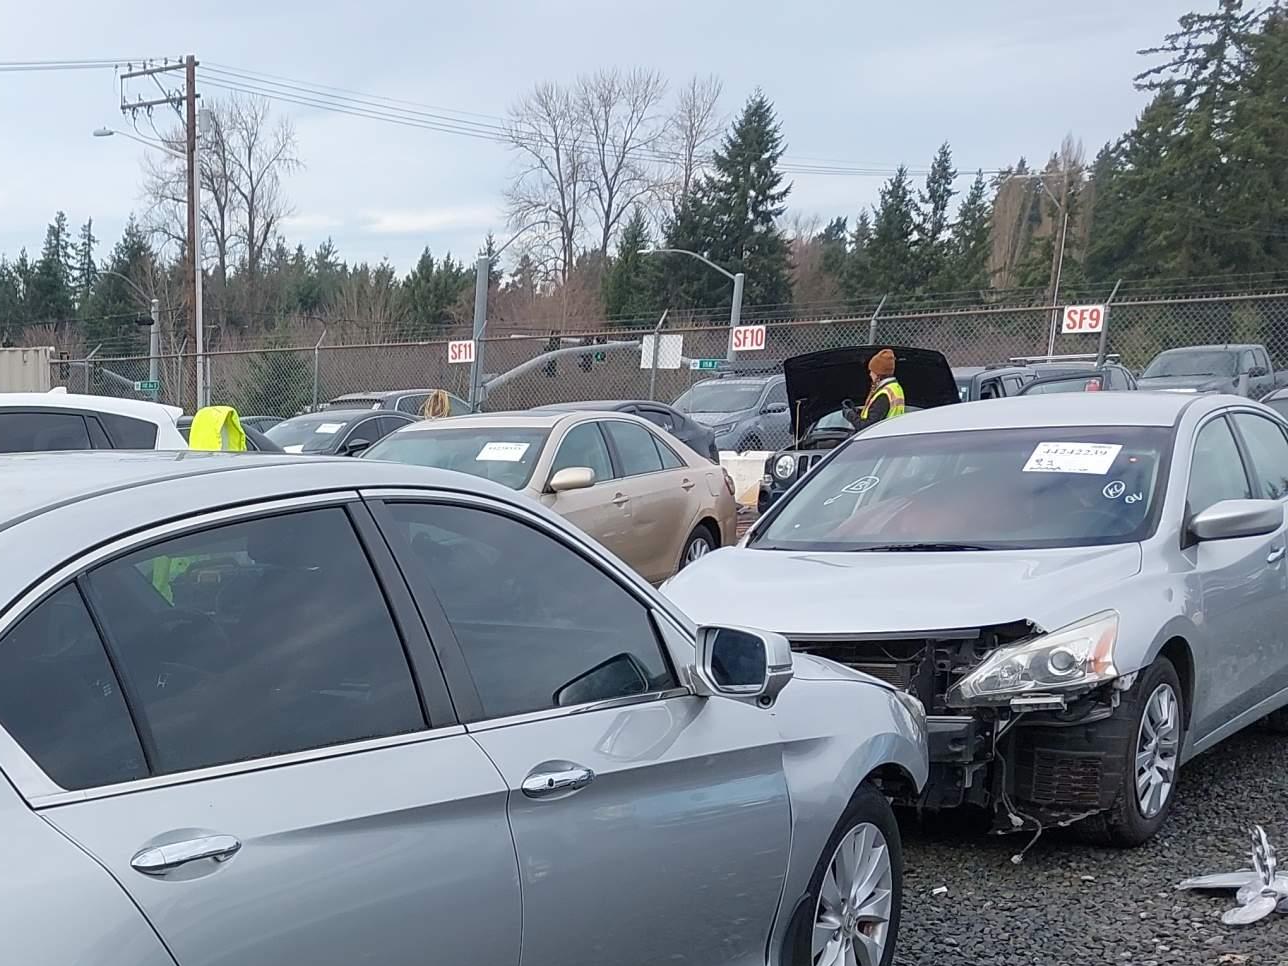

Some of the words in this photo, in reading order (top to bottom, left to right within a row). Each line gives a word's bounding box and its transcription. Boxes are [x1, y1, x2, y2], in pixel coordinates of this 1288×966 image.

[1066, 308, 1101, 330] SF9
[733, 327, 764, 348] SF10
[450, 343, 472, 360] SF11
